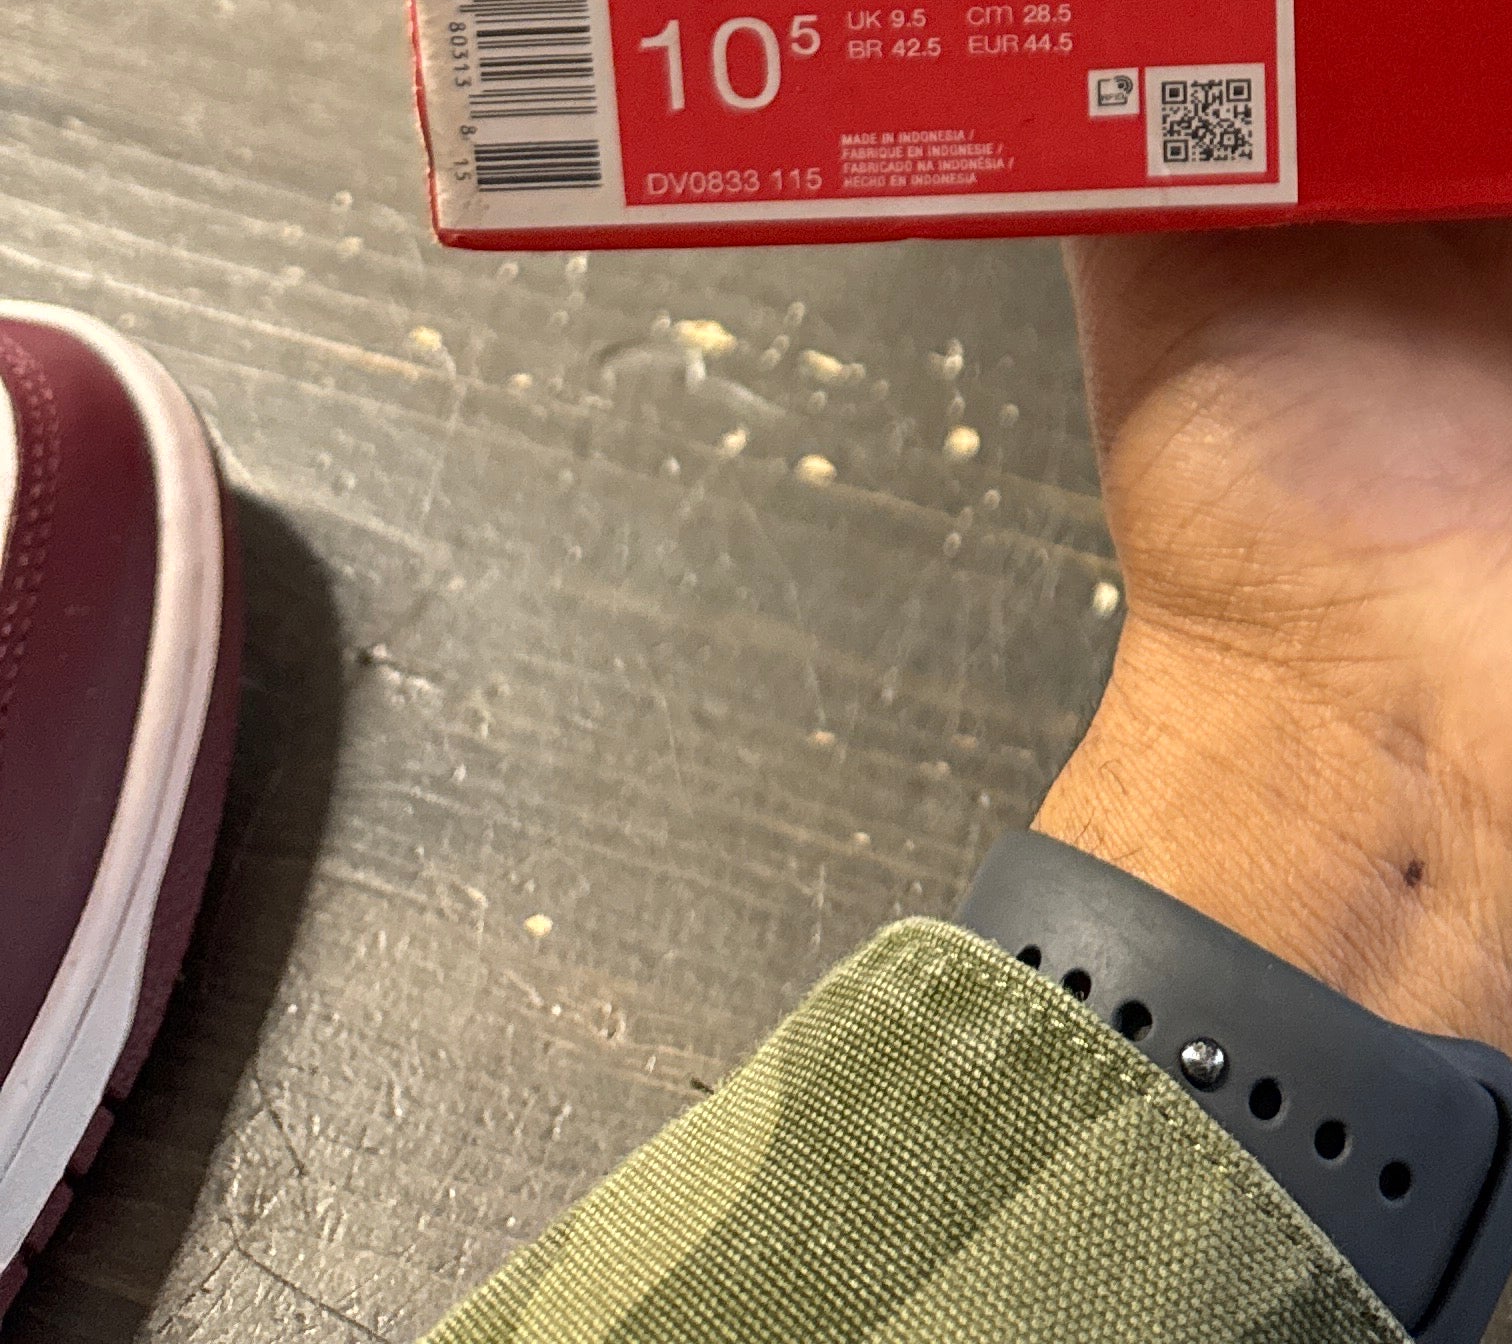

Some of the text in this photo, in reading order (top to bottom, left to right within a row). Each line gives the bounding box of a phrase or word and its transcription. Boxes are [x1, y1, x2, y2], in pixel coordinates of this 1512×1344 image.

[847, 11, 882, 30] UK
[891, 9, 927, 29] 9.5
[1023, 4, 1072, 24] 28.5
[449, 21, 472, 88] 80313
[848, 32, 1074, 60] BR 42.5 EUR 44.5
[639, 14, 821, 113] 10 5
[841, 133, 877, 145] MADE
[881, 132, 895, 145] IN
[899, 130, 965, 144] INDONESIA
[842, 146, 904, 159] FABRIQUE
[907, 145, 923, 158] EN
[843, 160, 913, 174] FABRICADO
[917, 160, 935, 172] NA
[647, 167, 824, 197] DV0833 115
[844, 174, 887, 188] HECHO
[890, 174, 907, 187] EN
